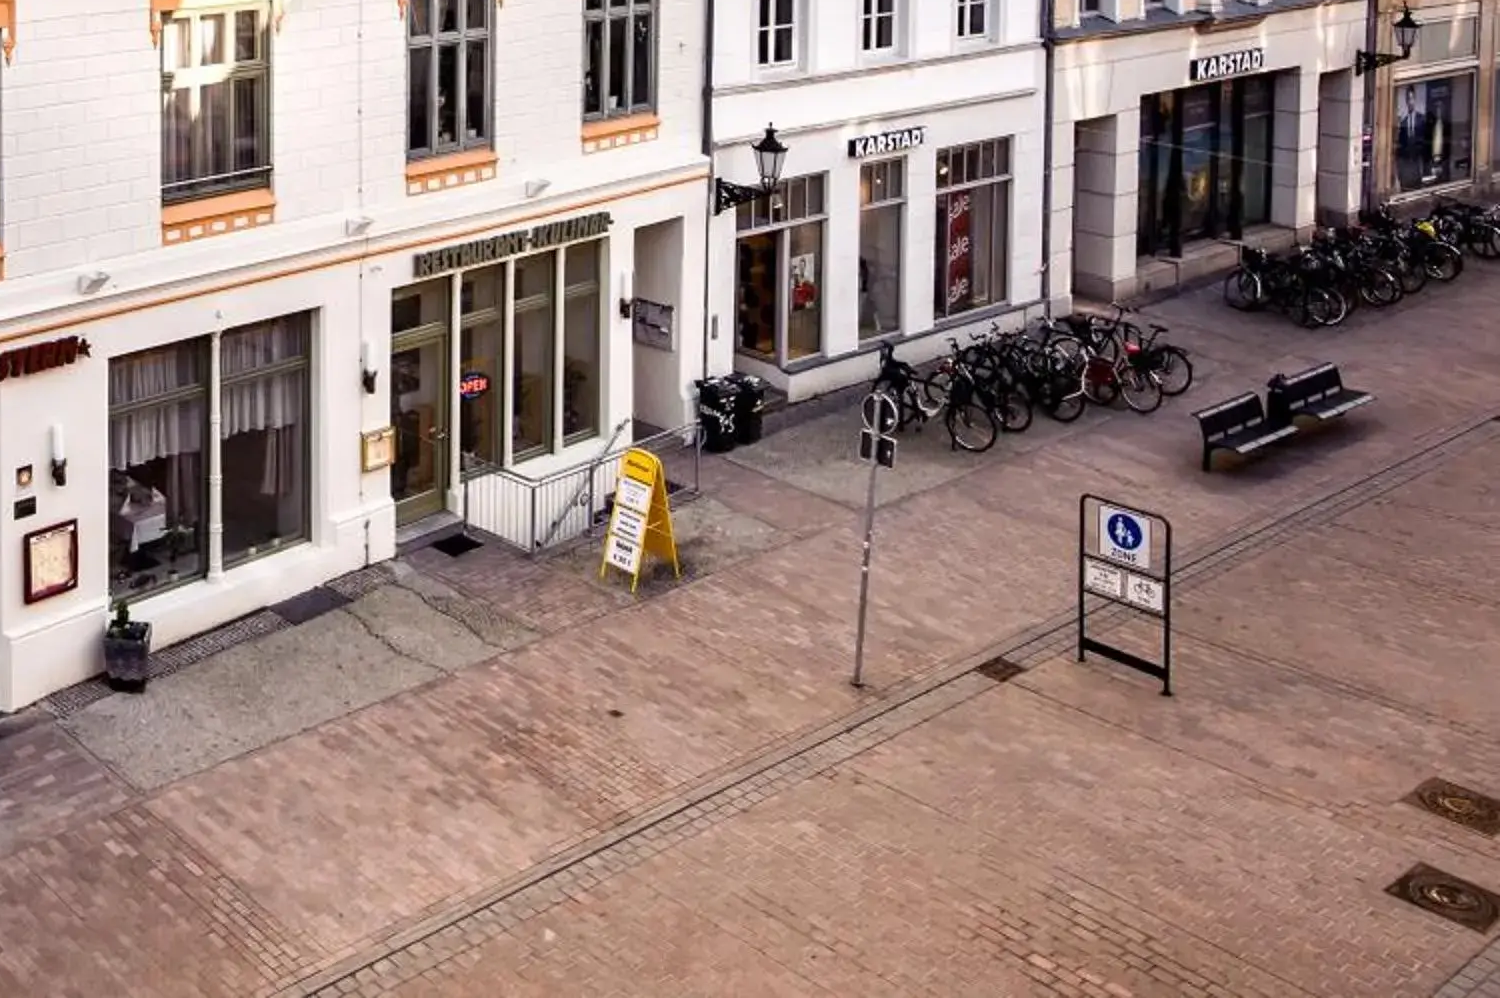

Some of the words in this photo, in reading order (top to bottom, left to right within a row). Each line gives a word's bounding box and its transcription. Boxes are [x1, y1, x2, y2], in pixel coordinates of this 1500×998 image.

[949, 236, 970, 261] ale
[948, 278, 969, 303] ale
[459, 377, 488, 394] OPEN
